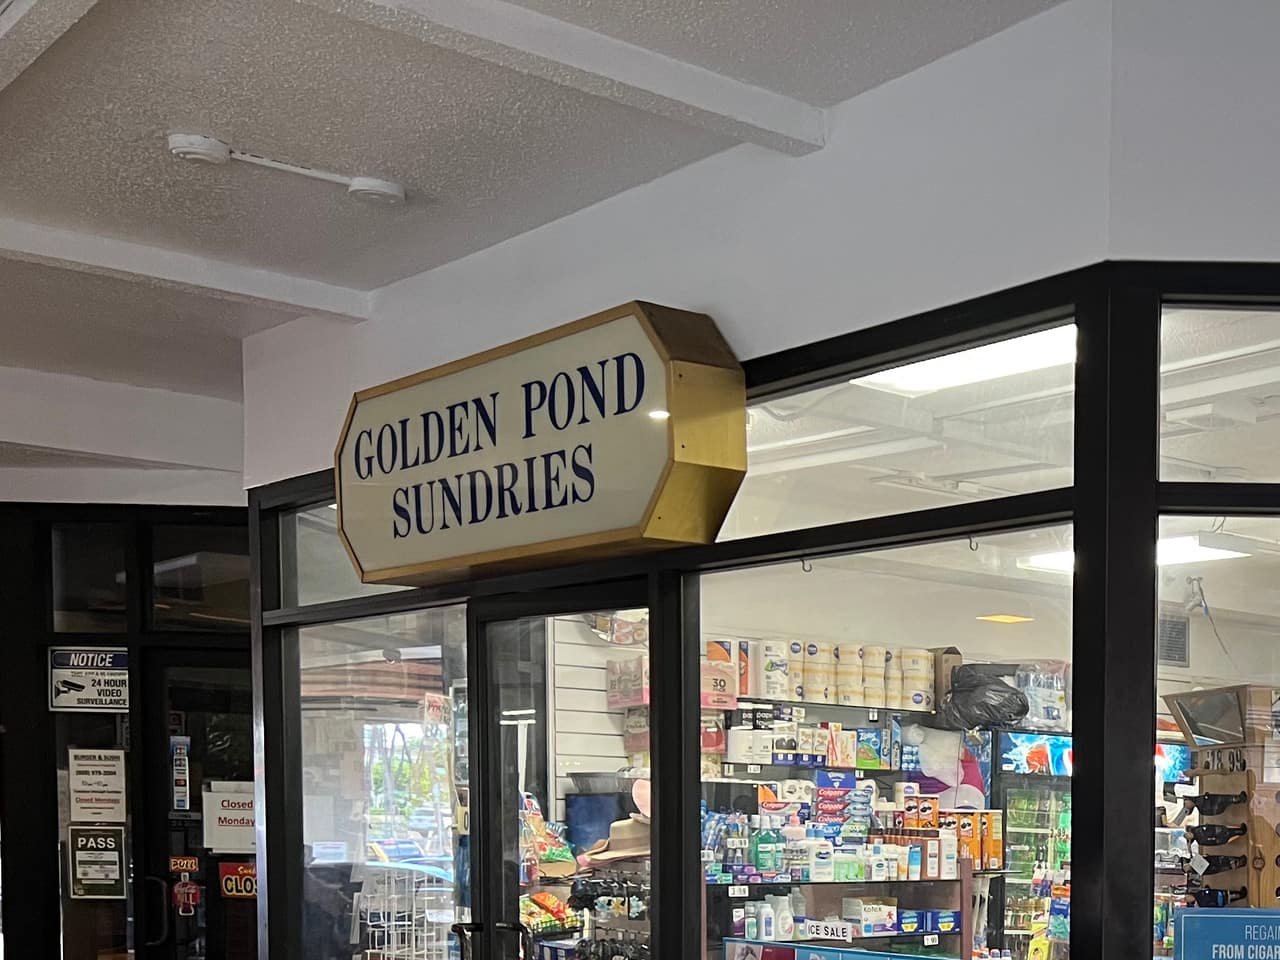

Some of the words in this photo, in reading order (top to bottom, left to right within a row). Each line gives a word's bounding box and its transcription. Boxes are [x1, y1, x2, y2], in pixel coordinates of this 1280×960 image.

[354, 392, 500, 480] GOLDEN
[521, 352, 645, 439] POND
[393, 443, 595, 539] SUNDRIES
[70, 653, 113, 666] NOTICE
[91, 679, 101, 687] 24
[104, 679, 127, 687] HOUR
[712, 678, 726, 688] 30
[97, 689, 122, 697] VIDEO
[221, 800, 254, 809] Closed
[78, 838, 115, 848] PASS
[808, 923, 820, 935] ICE
[824, 926, 848, 938] SALE
[1212, 944, 1244, 960] FROM
